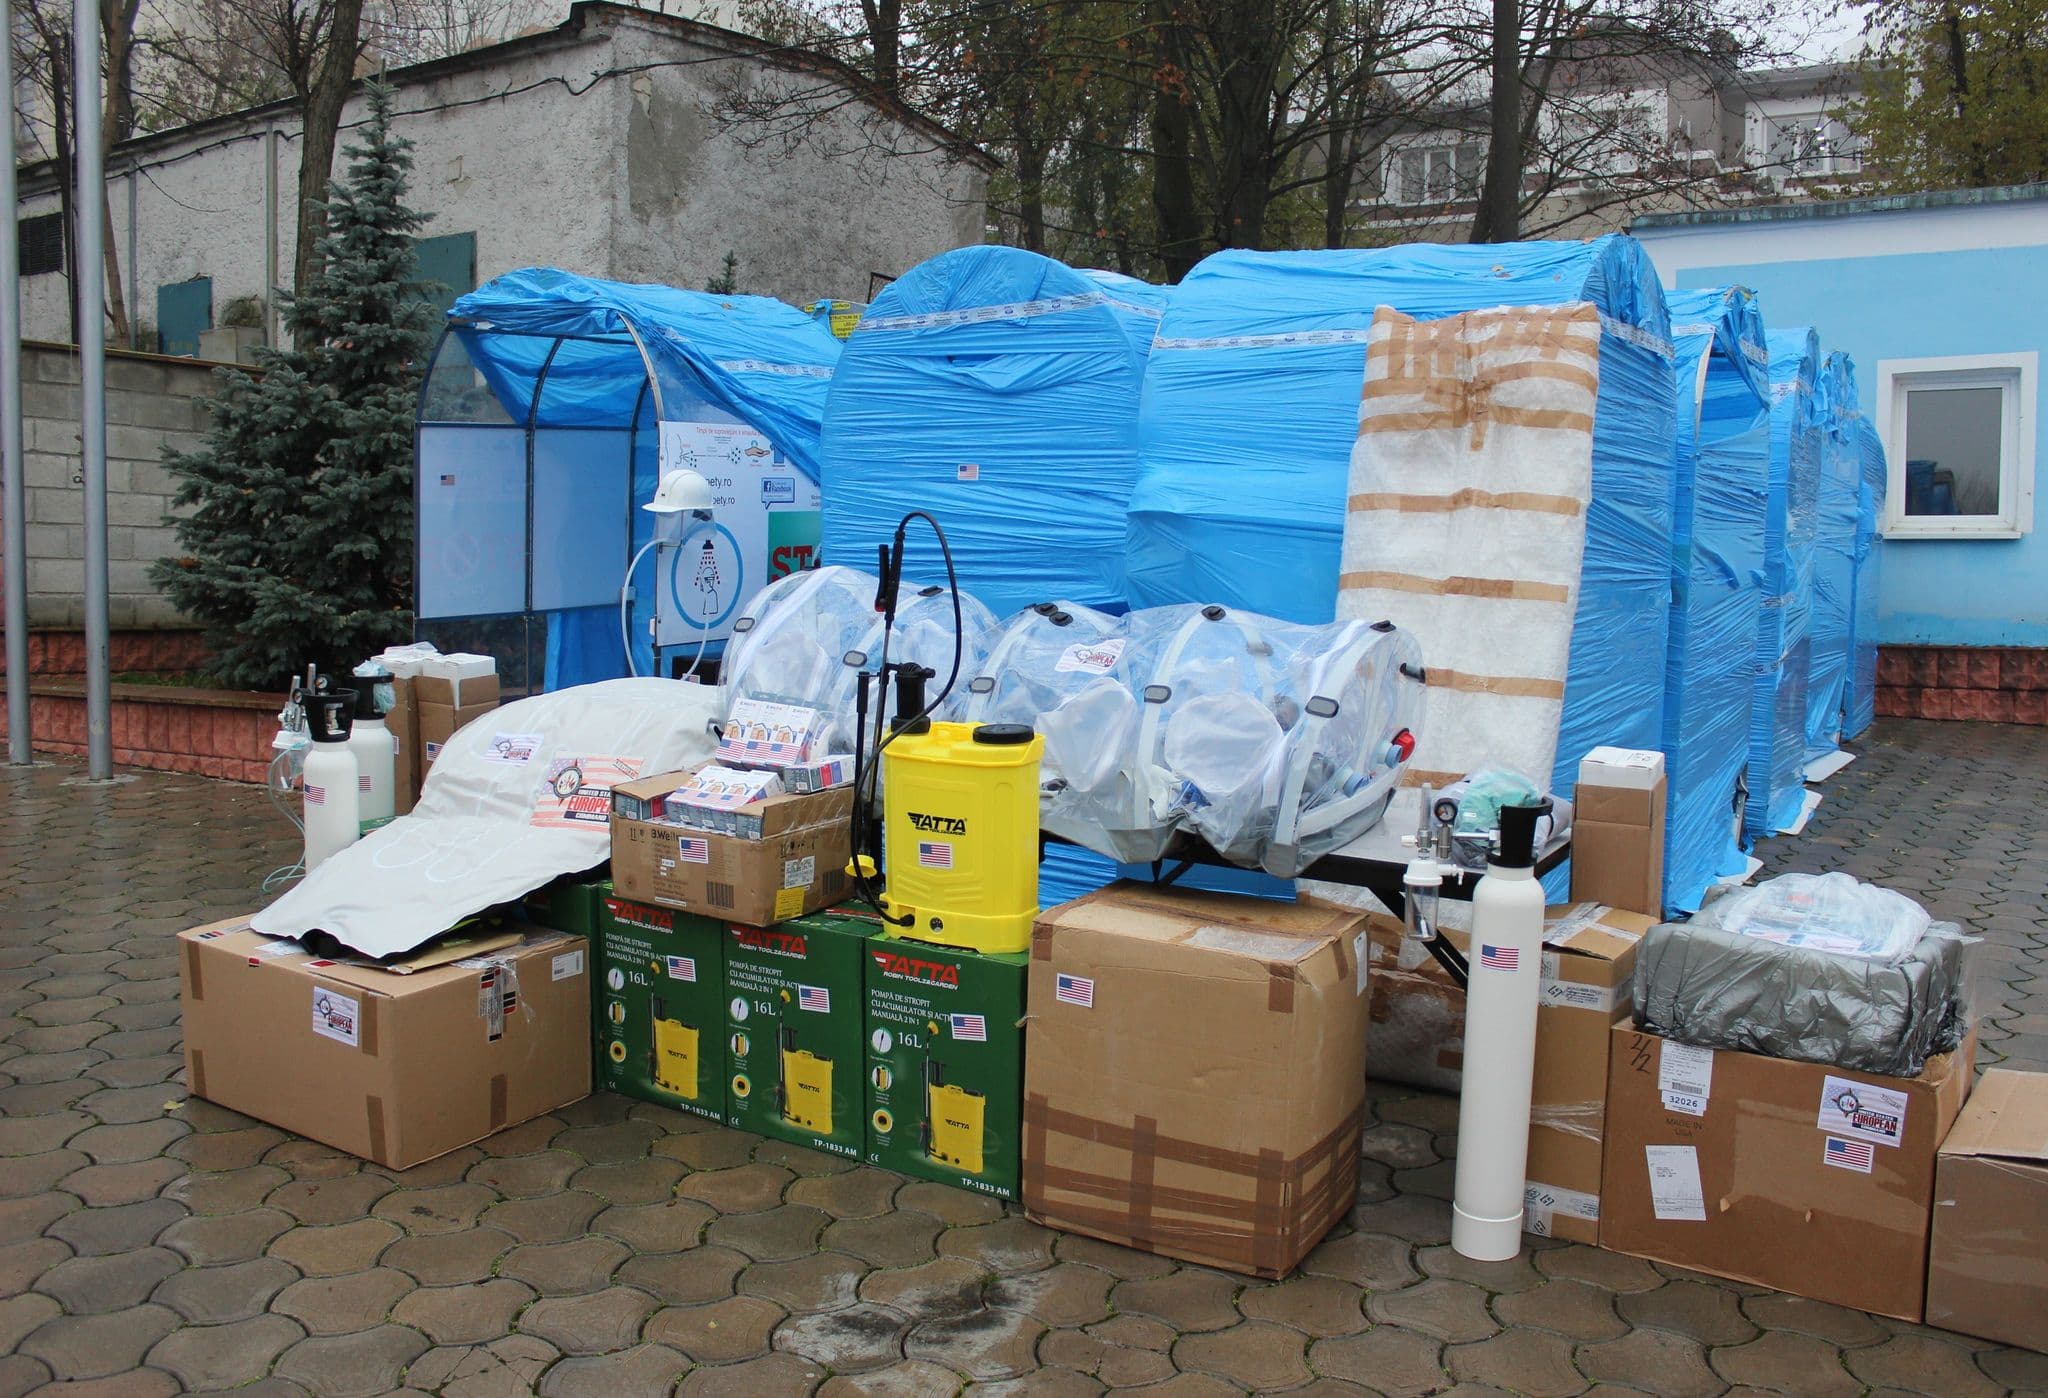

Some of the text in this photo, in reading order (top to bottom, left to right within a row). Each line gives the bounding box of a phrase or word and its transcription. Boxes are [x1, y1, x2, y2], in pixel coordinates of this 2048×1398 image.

[770, 545, 813, 583] ST
[599, 790, 611, 798] STA
[907, 811, 966, 833] TATTA
[604, 898, 673, 929] TATTA
[727, 924, 807, 955] TATTA
[871, 950, 960, 986] TATTA
[628, 970, 648, 986] 16L
[753, 1000, 776, 1016] 16L
[881, 1001, 927, 1018] ACUMULATOR
[897, 1032, 923, 1049] 16L
[1669, 1095, 1698, 1108] 32026
[709, 1111, 721, 1120] AM
[1852, 1112, 1897, 1132] EUROPEAN
[813, 1138, 857, 1156] TP-1833 AM
[961, 1177, 1010, 1197] TP-1833 AM
